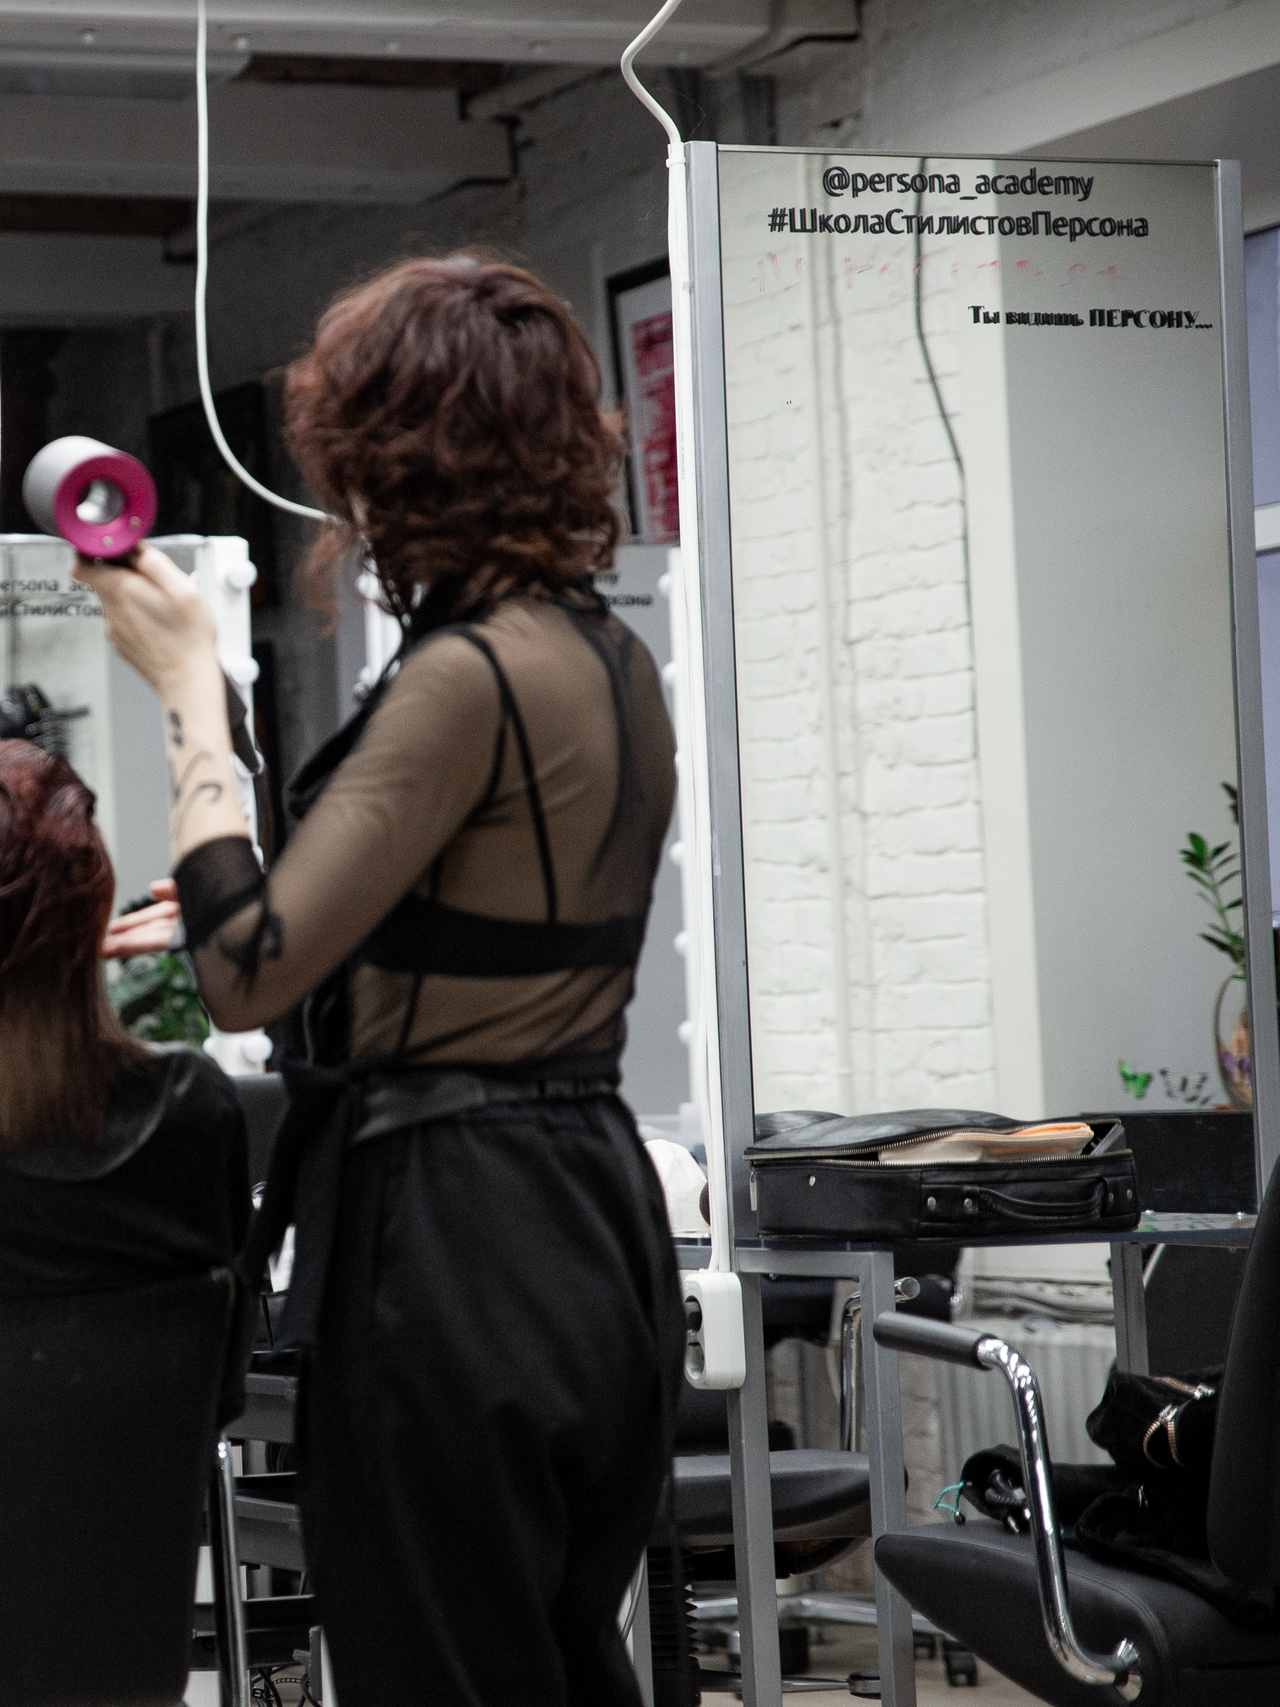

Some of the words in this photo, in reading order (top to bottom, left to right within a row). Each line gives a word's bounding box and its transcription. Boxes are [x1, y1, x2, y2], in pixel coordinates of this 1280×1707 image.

[822, 166, 1095, 201] @persona_academy
[767, 207, 1149, 241] #ШколаСтилистовПерсона
[968, 305, 1000, 324] Ты
[1005, 310, 1085, 327] видишь
